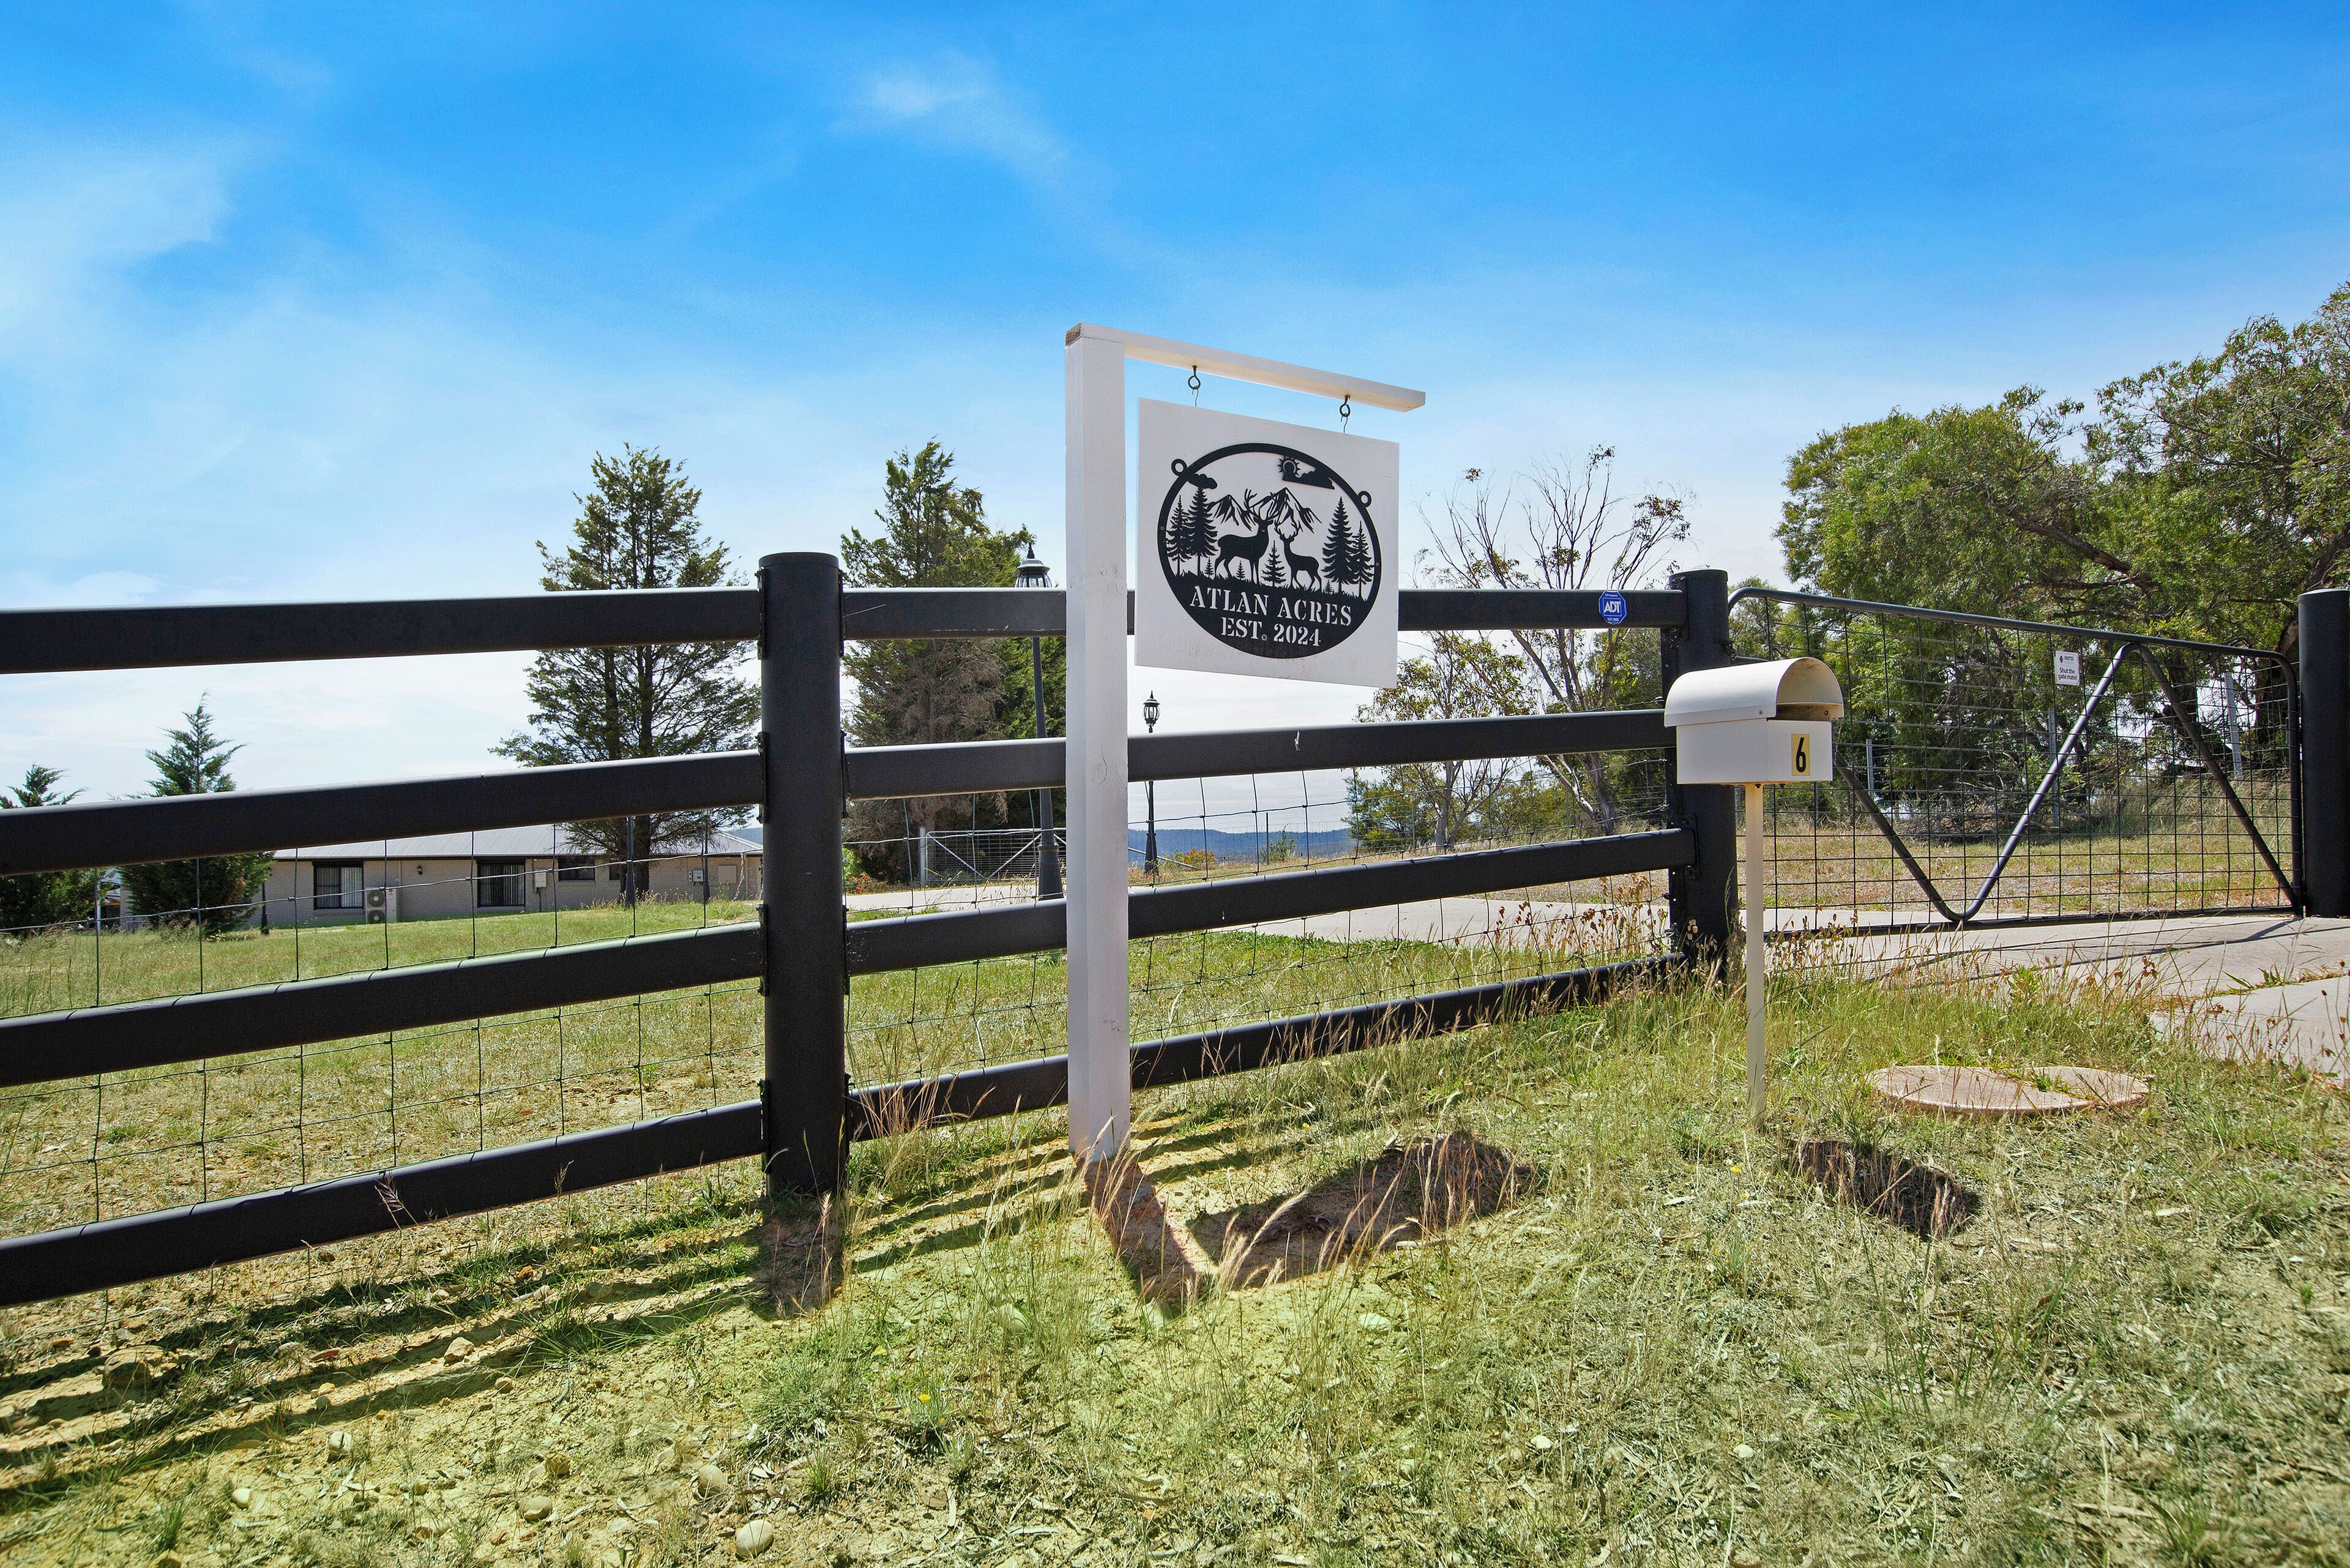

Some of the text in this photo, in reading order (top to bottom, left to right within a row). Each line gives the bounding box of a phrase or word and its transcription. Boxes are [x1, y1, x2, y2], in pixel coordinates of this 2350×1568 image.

[1190, 585, 1352, 627] ATLAN ACRES
[1603, 600, 1621, 613] ADT
[1221, 616, 1321, 647] EST. 2024
[1796, 737, 1807, 773] 6
